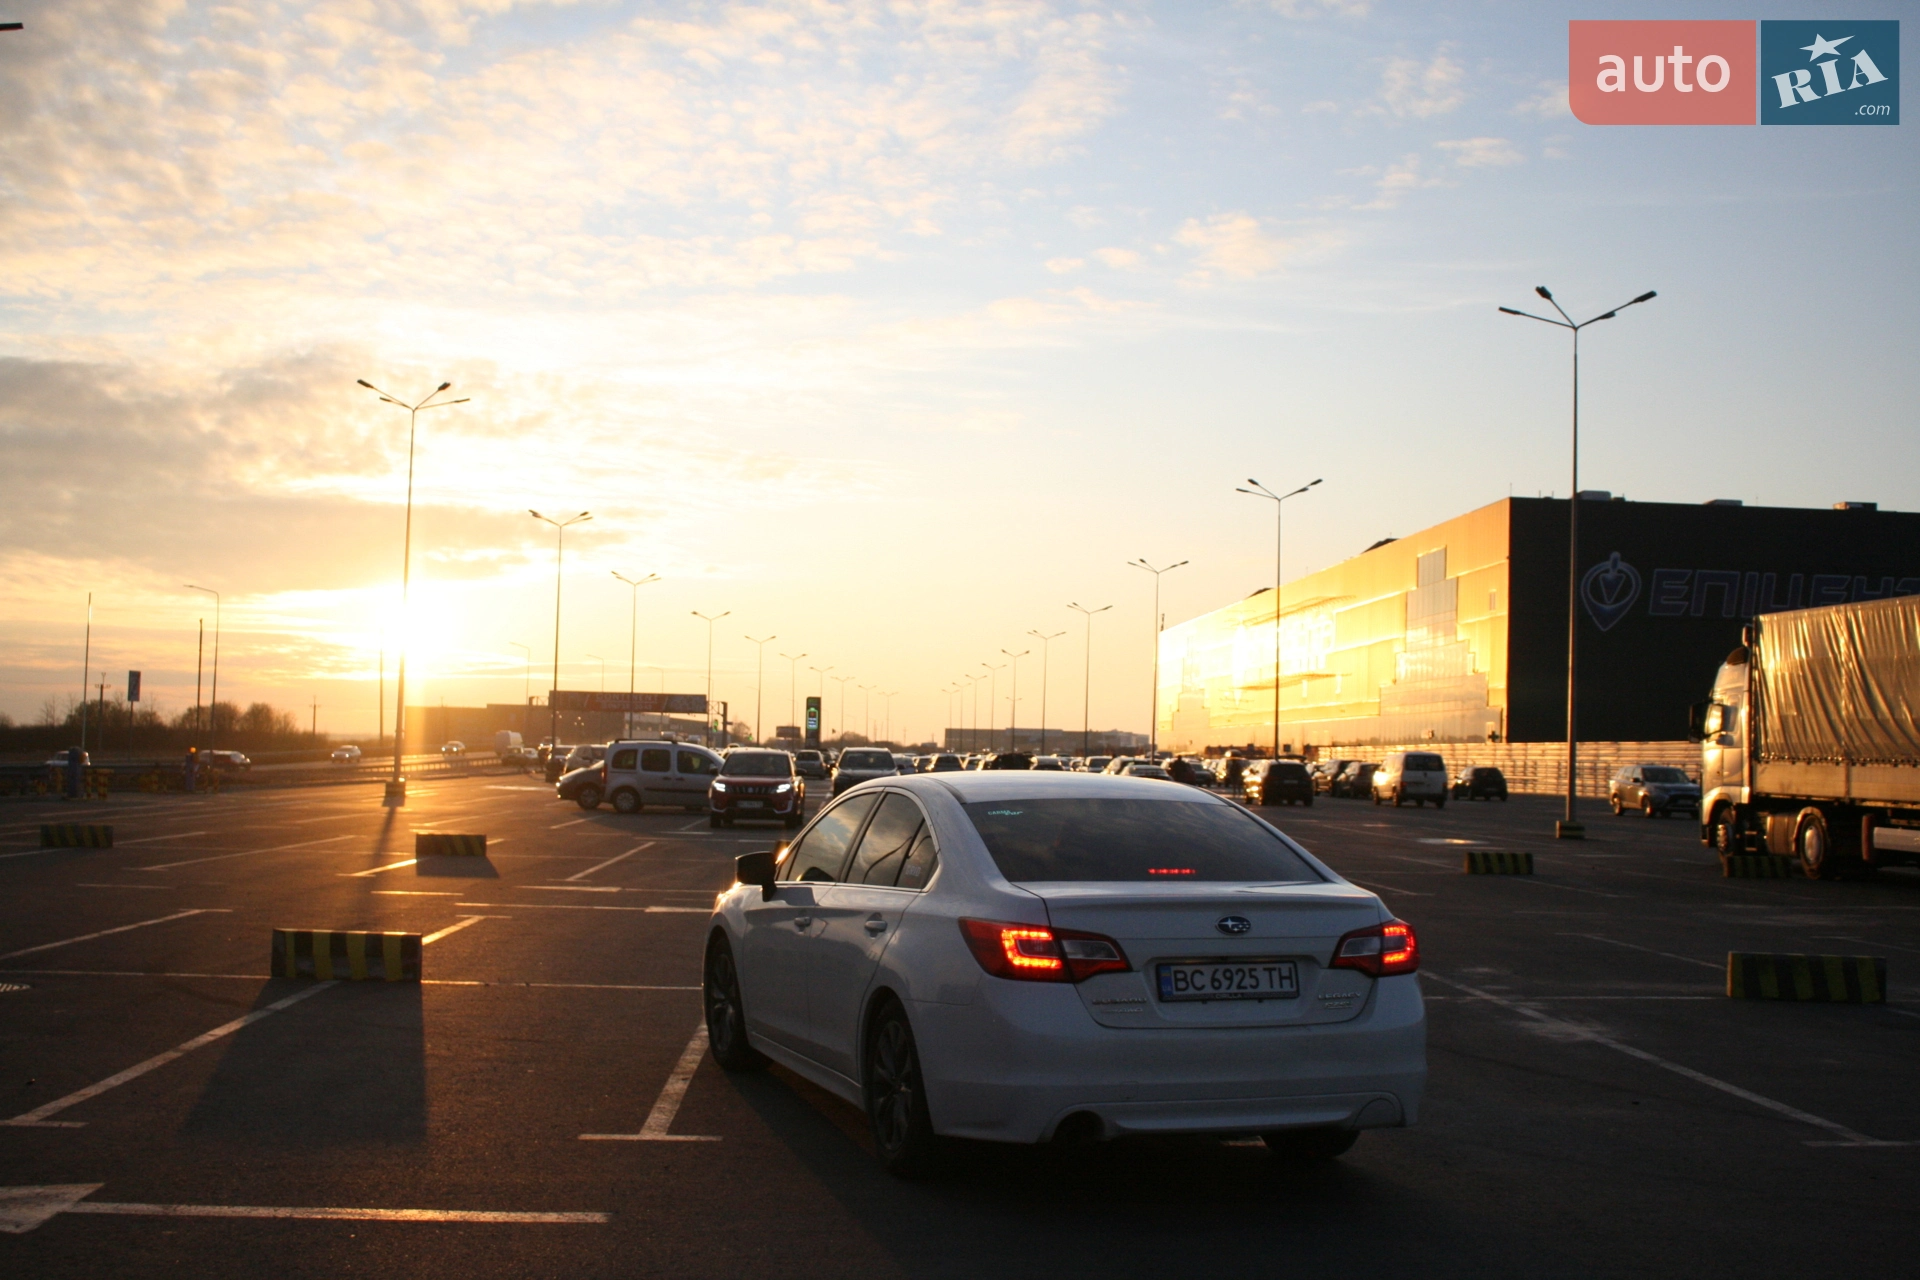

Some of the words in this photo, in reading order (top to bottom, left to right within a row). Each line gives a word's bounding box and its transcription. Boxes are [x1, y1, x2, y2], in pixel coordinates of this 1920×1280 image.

[1173, 968, 1206, 992] BC
[1210, 967, 1260, 990] 6925
[1262, 967, 1294, 989] TH
